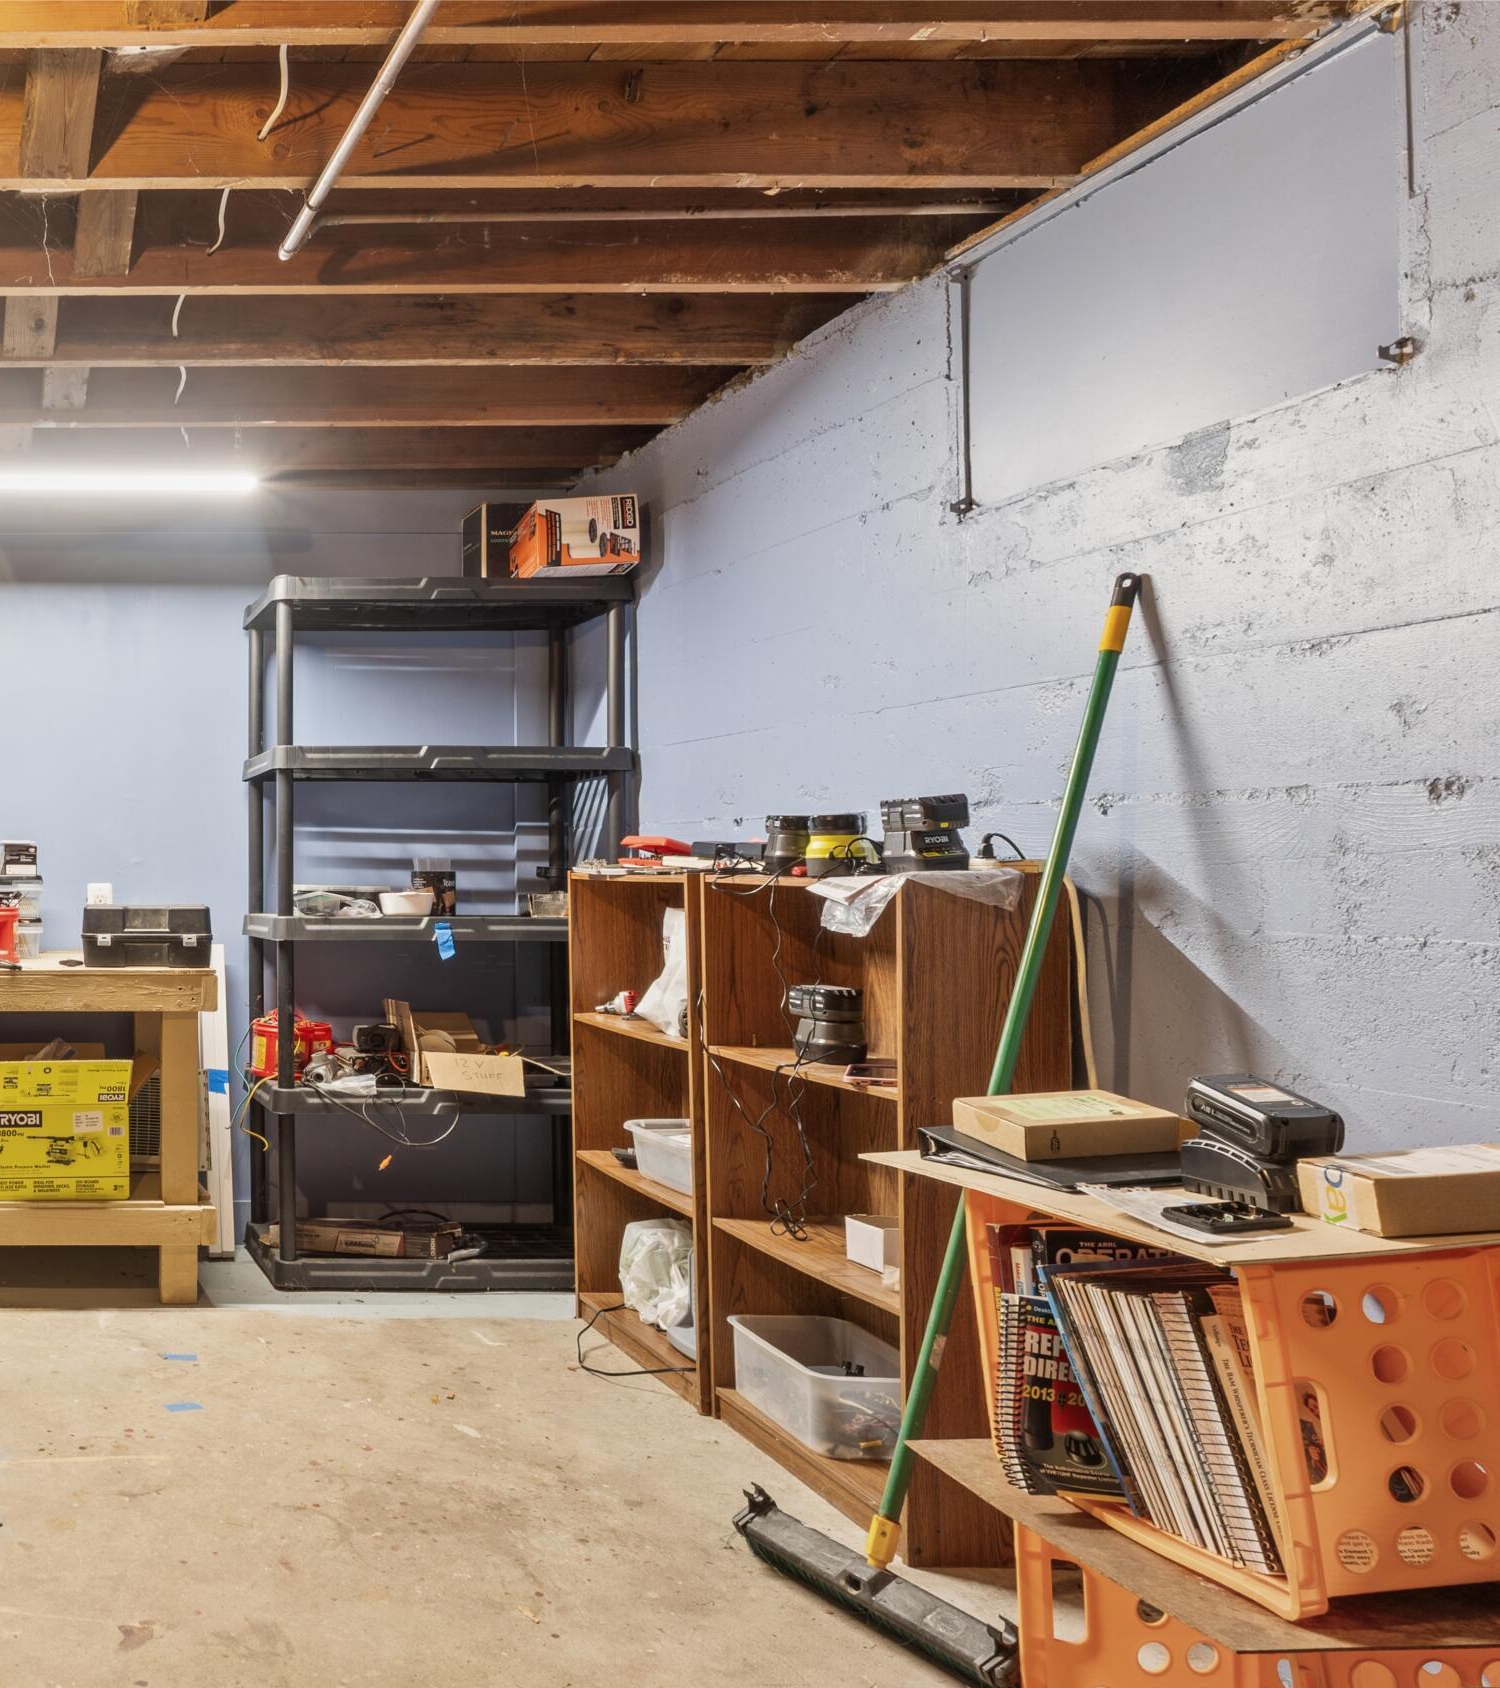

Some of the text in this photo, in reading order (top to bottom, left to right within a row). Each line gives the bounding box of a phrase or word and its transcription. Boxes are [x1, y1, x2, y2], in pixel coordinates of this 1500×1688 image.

[626, 498, 634, 527] RIDGID
[924, 835, 949, 844] RYOBI
[455, 1057, 484, 1069] 12 V
[461, 1070, 504, 1081] STUFF
[0, 1113, 41, 1126] RYOBI
[1026, 1315, 1046, 1325] THE
[1022, 1385, 1056, 1402] 2013
[1226, 1370, 1237, 1387] HAM
[1232, 1387, 1250, 1432] WHISPERER'S
[1246, 1431, 1263, 1471] TECHNICIAN
[1259, 1470, 1270, 1492] CLASS
[1266, 1491, 1281, 1521] LICENSE
